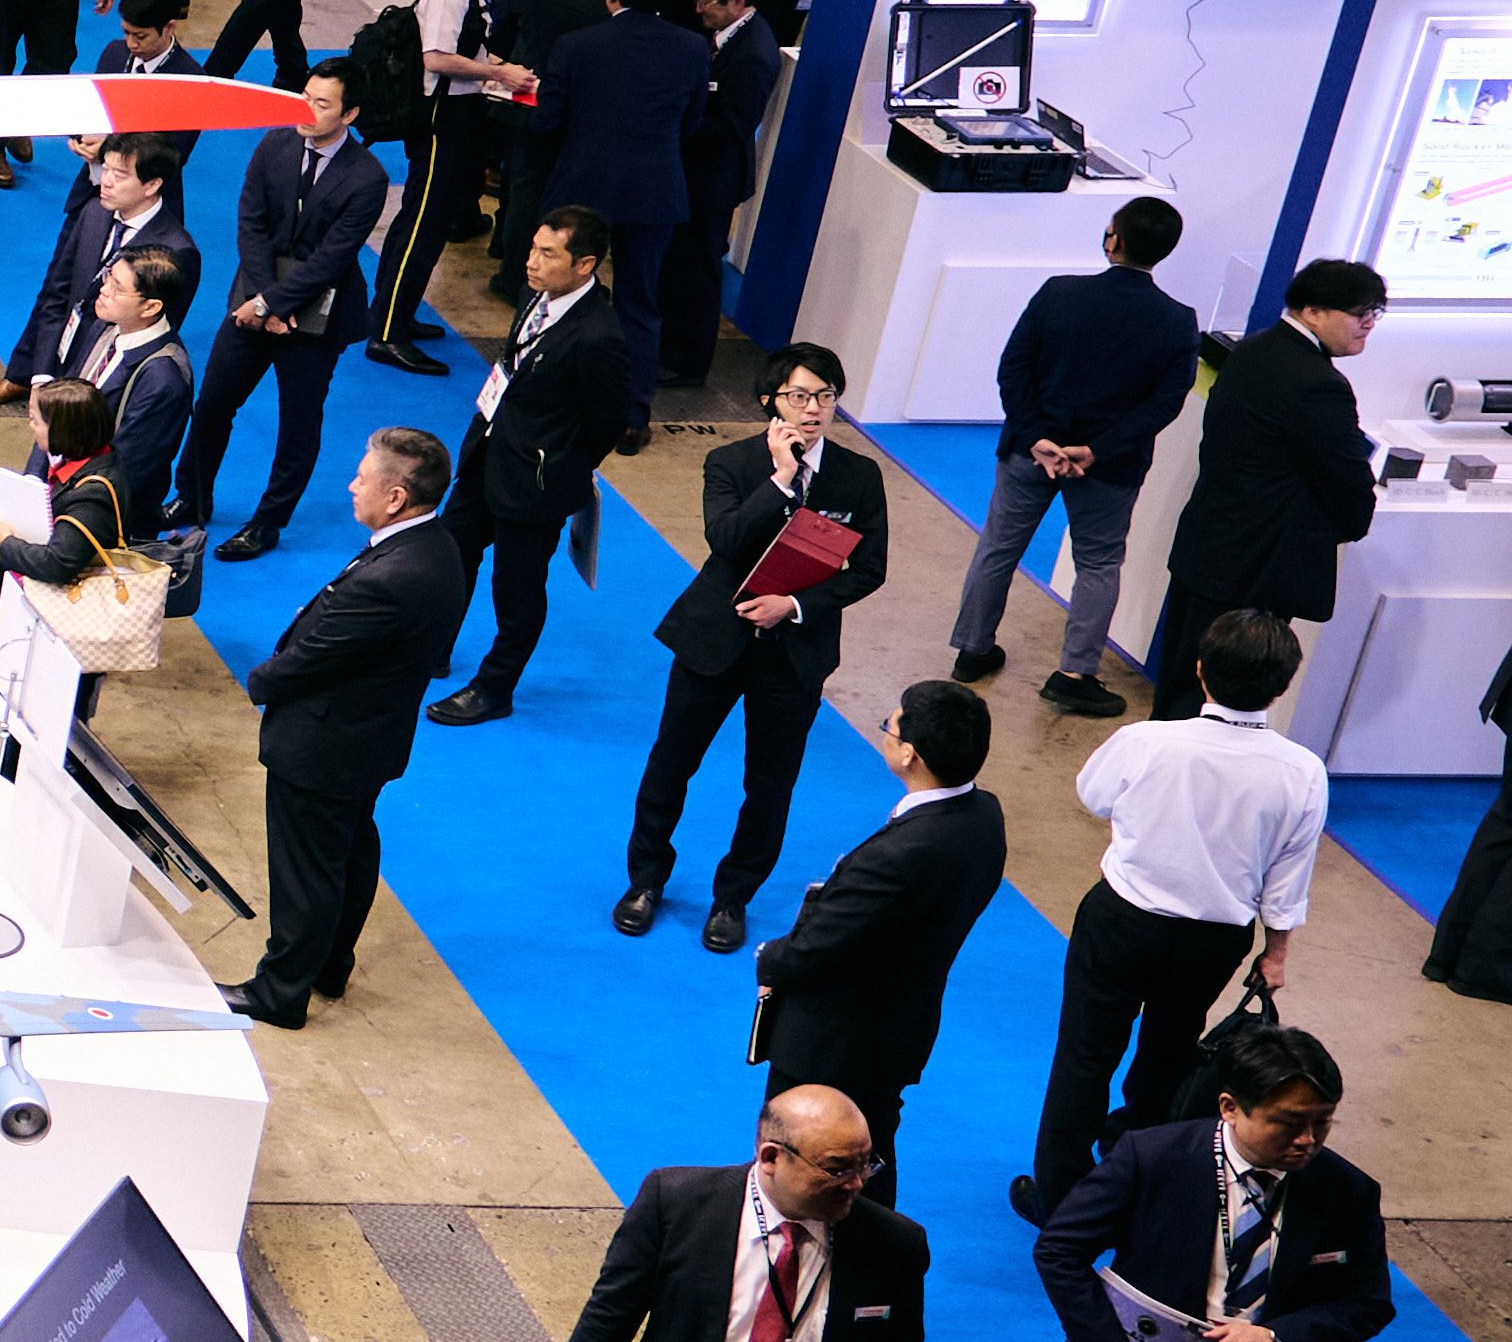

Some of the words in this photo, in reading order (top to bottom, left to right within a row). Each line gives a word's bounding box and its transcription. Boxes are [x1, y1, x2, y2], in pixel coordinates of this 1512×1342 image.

[65, 1317, 77, 1339] to
[72, 1295, 96, 1326] Cold
[90, 1258, 129, 1305] Weather
